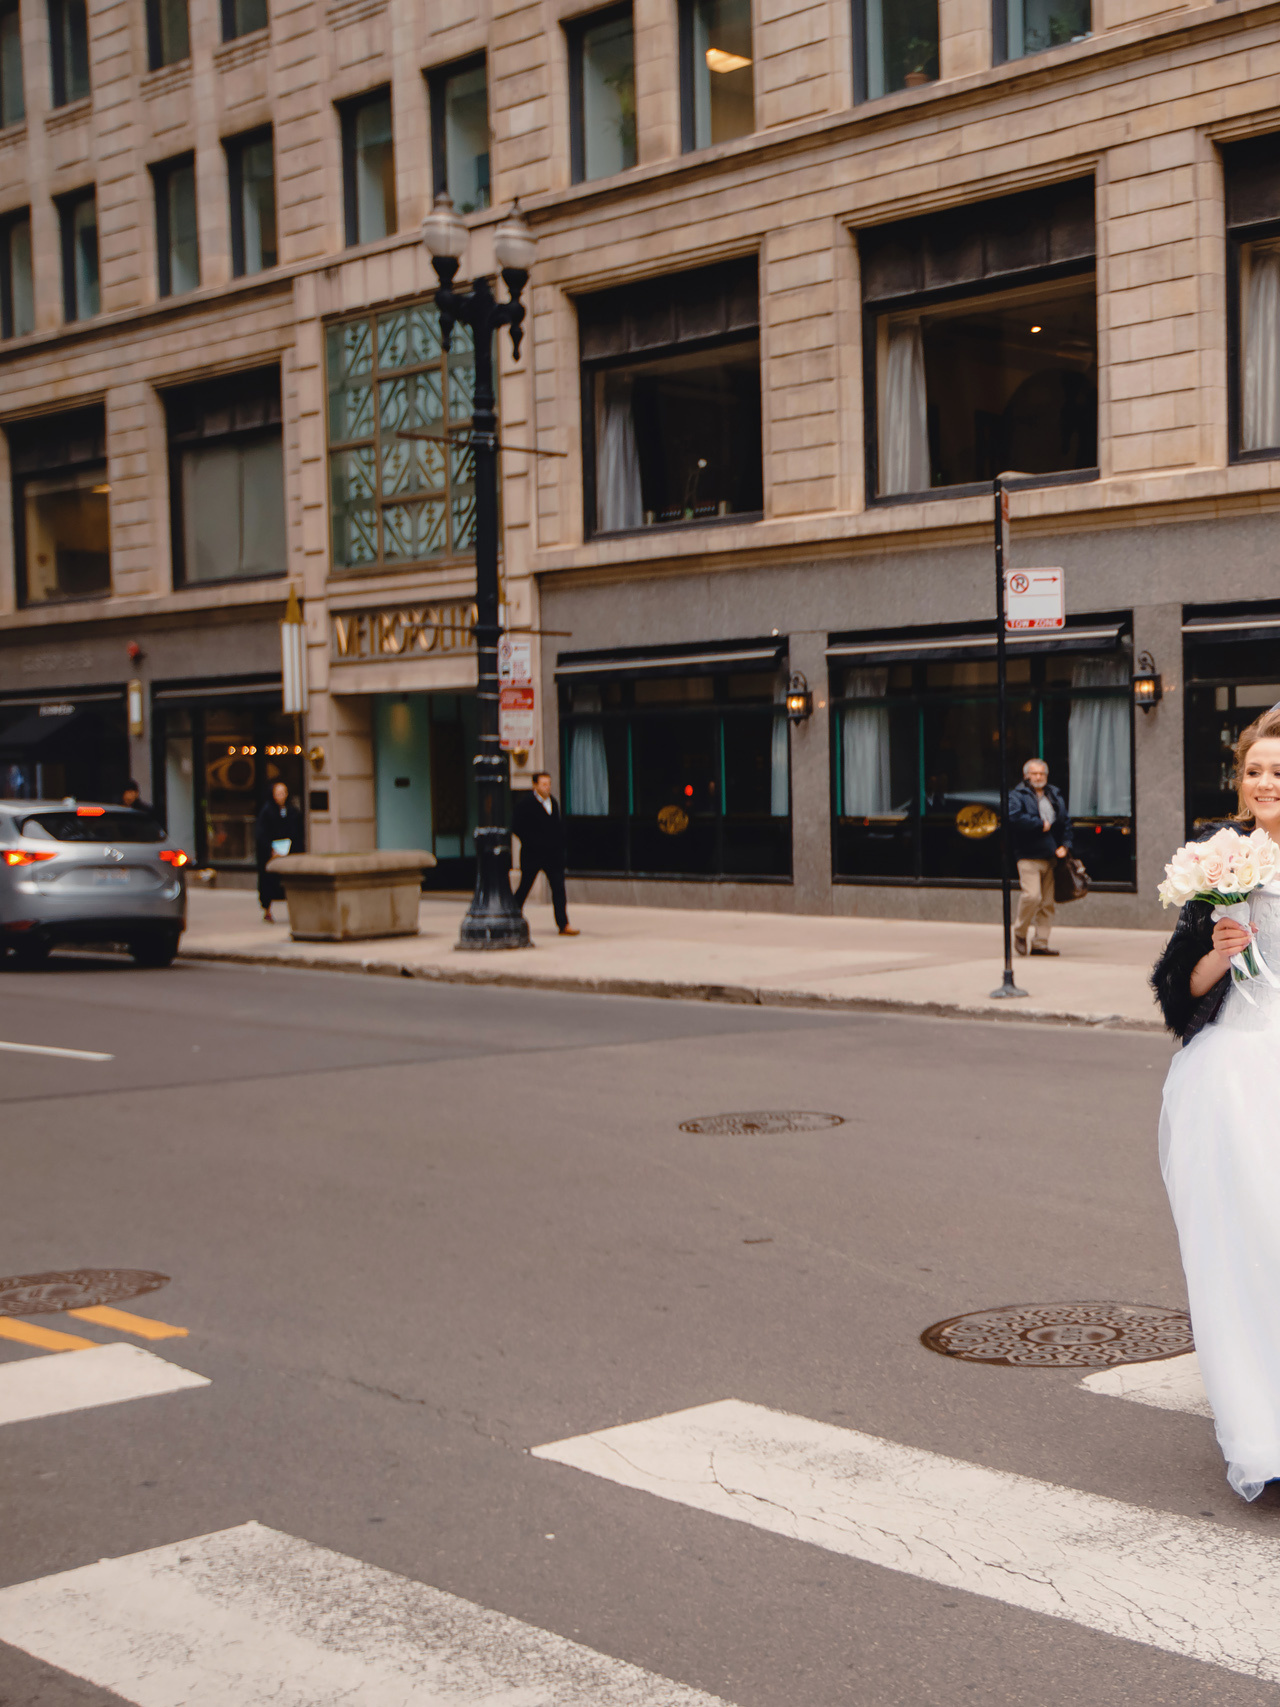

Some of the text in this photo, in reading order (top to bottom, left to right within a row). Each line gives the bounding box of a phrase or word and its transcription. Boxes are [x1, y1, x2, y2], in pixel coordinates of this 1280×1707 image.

[336, 604, 479, 656] METROPOLITA
[1011, 618, 1058, 628] TOW ZONE
